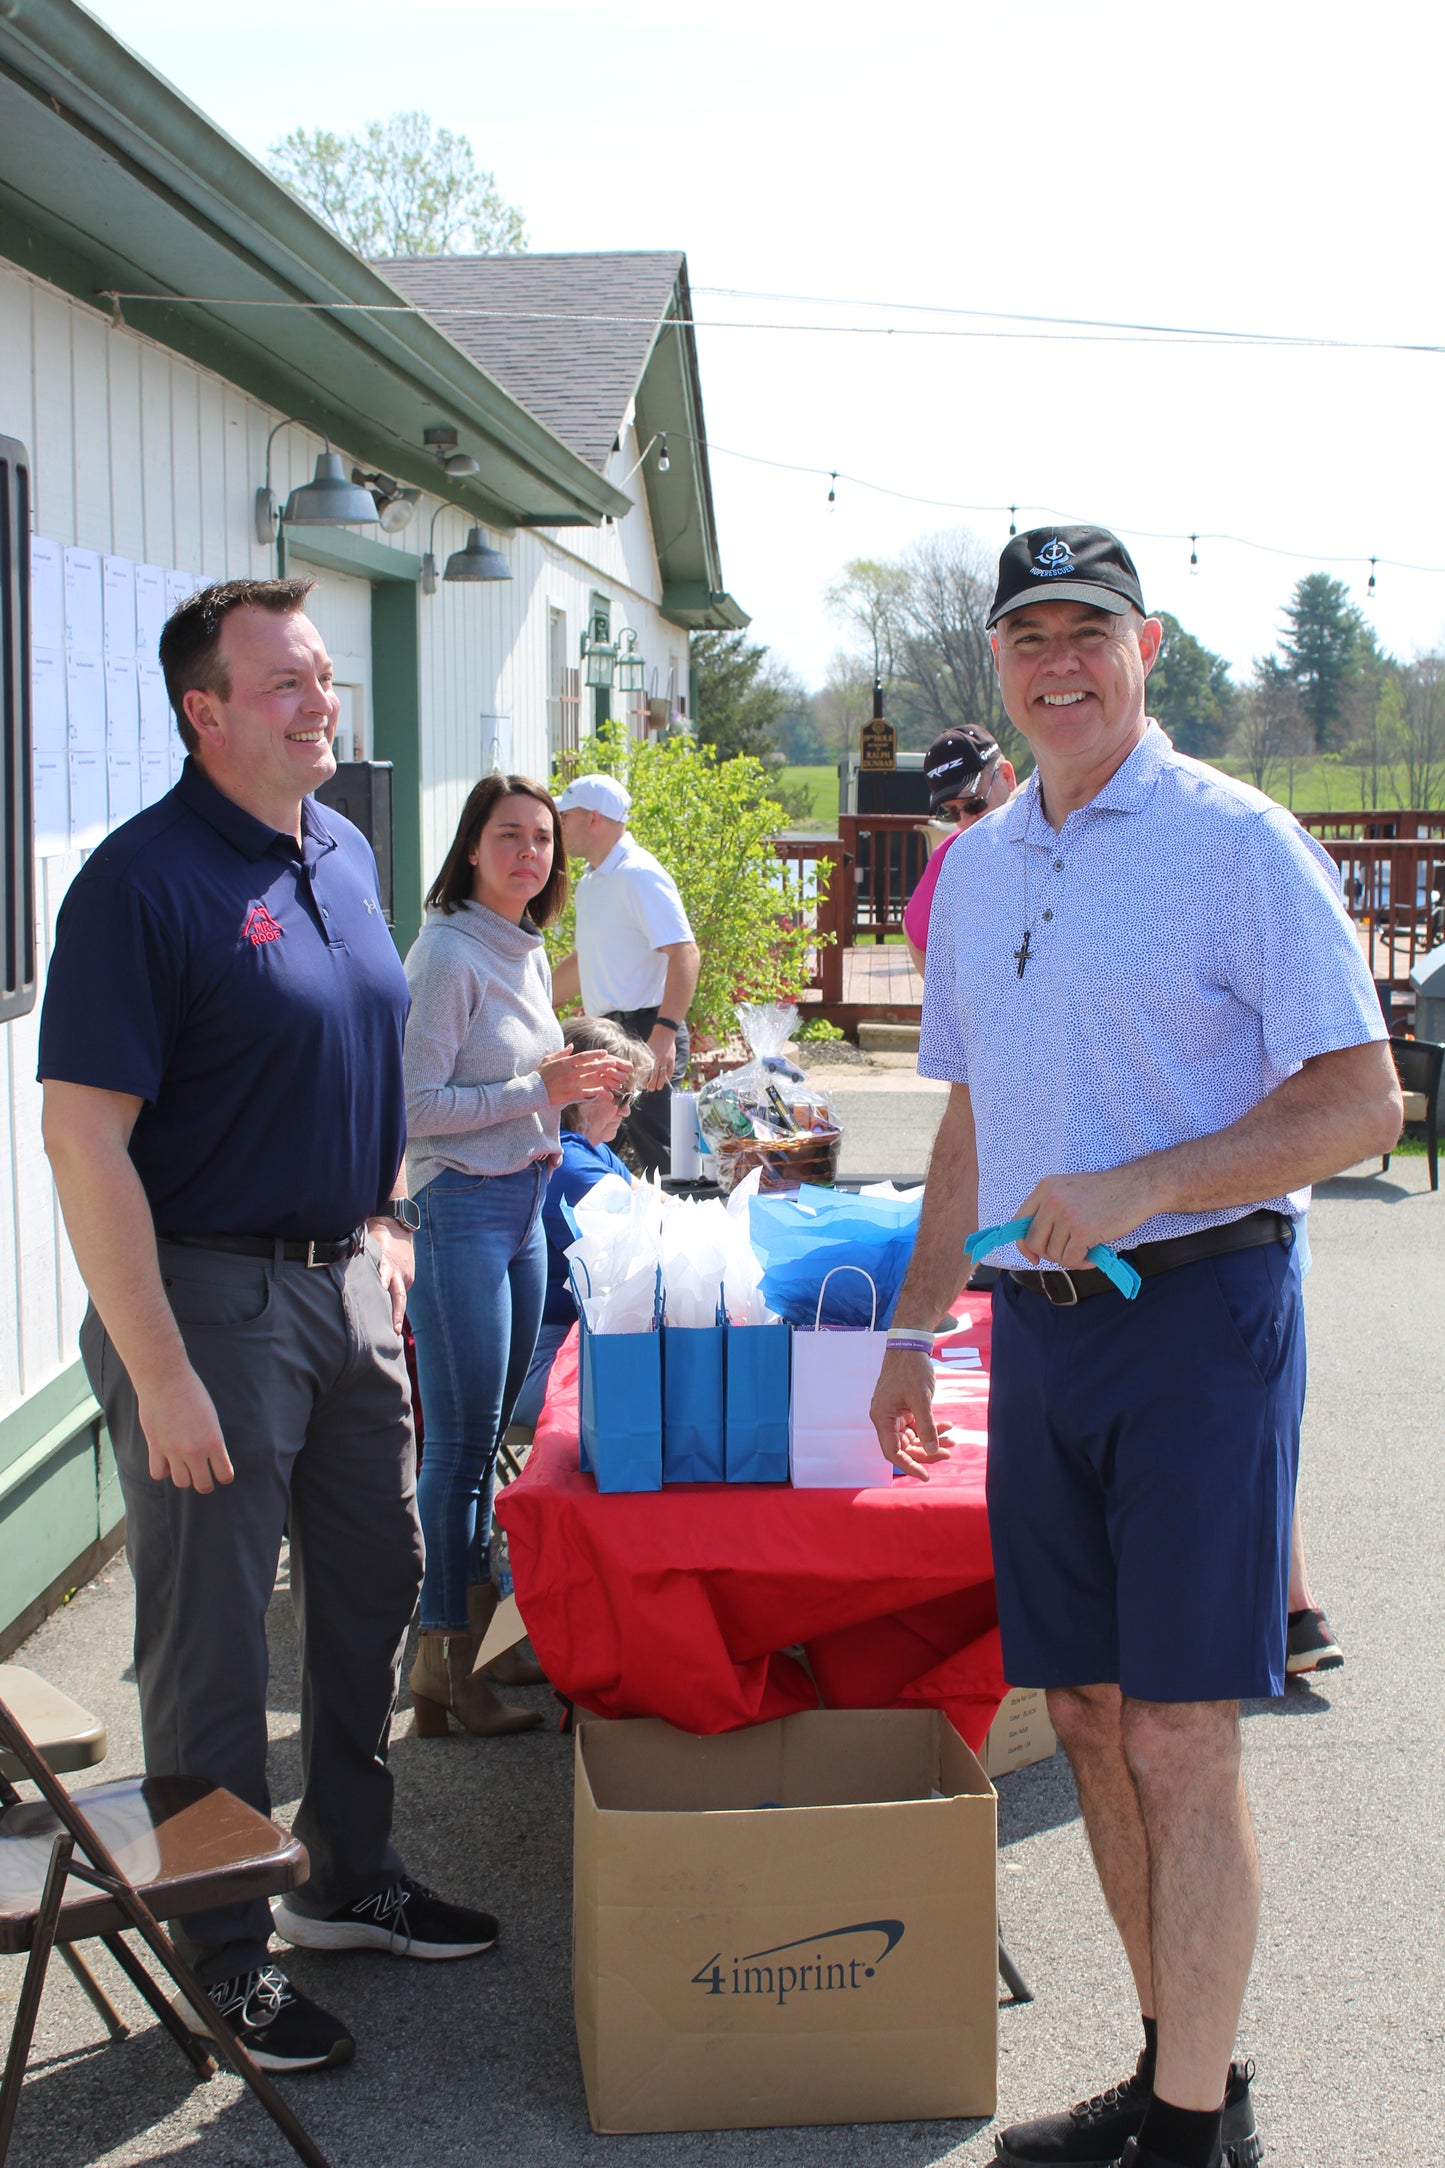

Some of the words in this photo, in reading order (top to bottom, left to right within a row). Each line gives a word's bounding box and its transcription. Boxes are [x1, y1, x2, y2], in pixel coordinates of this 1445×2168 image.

[1029, 564, 1075, 577] HOPERESCUED
[866, 751, 891, 759] RALPH
[926, 757, 963, 779] RBZ
[250, 930, 279, 946] ROOF
[690, 1953, 861, 2006] 4imprint
